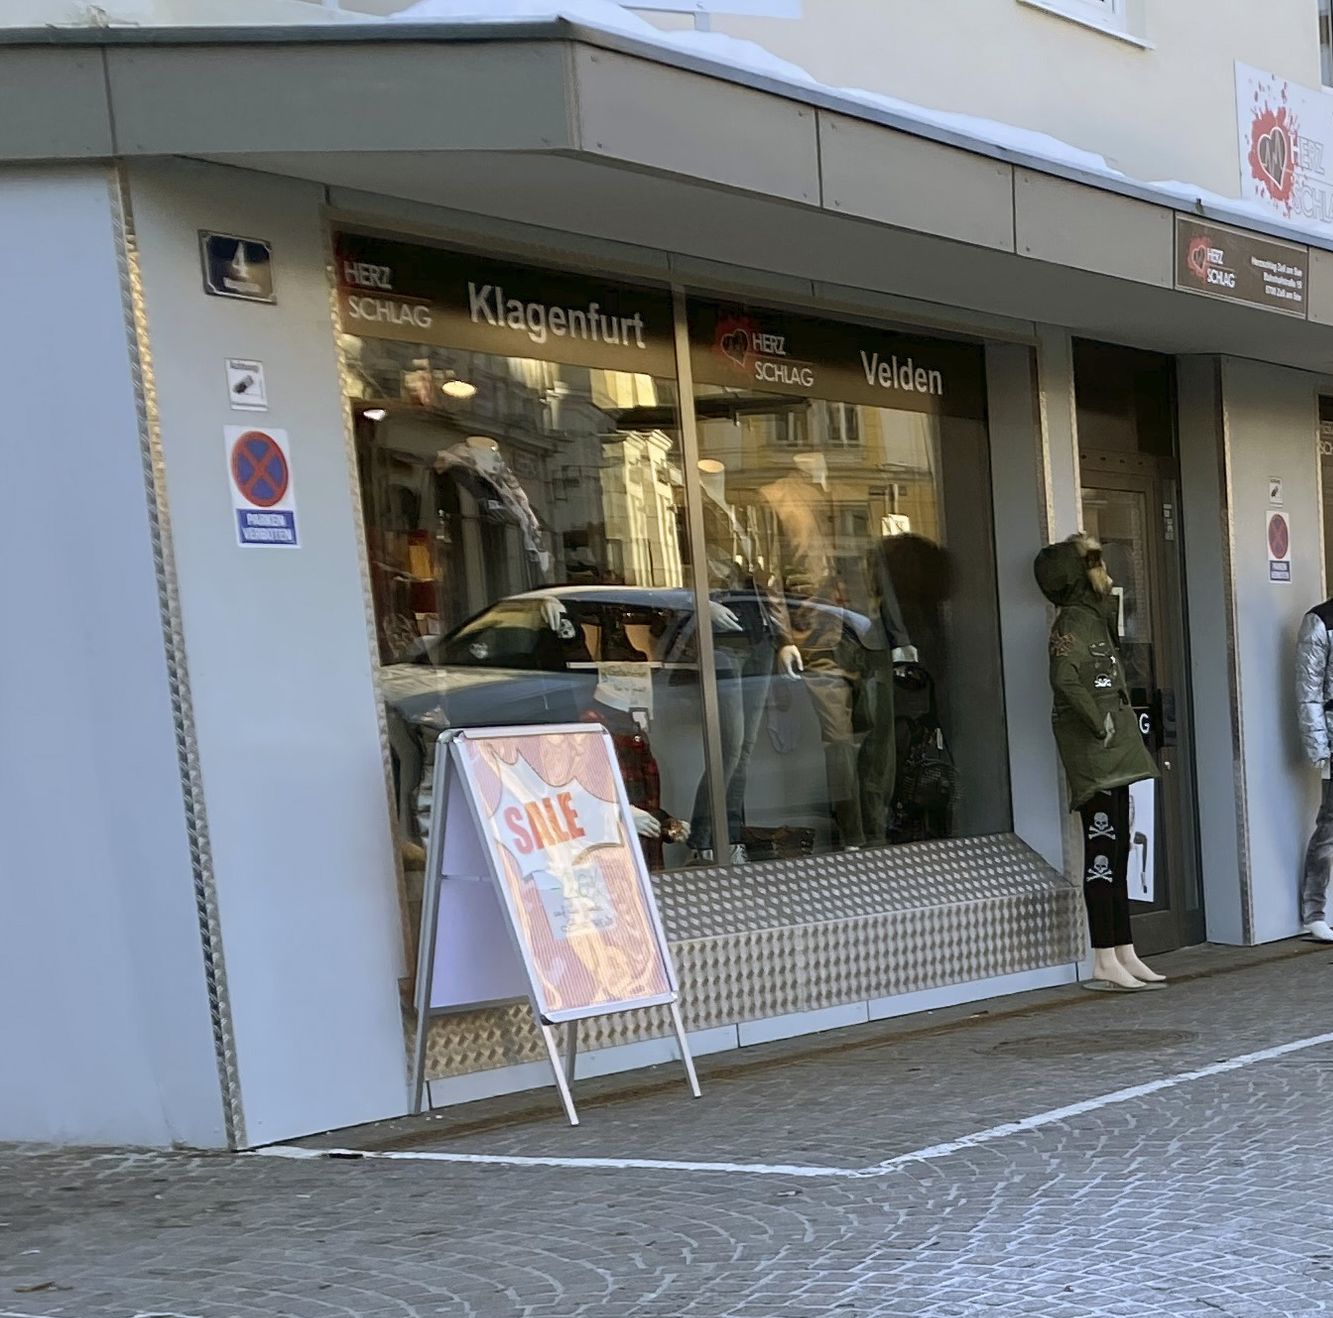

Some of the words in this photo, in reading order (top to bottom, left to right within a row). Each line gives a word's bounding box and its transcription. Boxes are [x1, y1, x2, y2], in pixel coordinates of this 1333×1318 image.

[232, 241, 250, 279] 4
[344, 261, 393, 290] HERZ
[1206, 268, 1236, 289] SCHLAG
[347, 295, 433, 329] SCHLAG
[467, 281, 647, 350] Klagenfurt
[752, 332, 787, 356] HERZ
[754, 361, 815, 388] SCHLAG
[860, 350, 944, 396] Velden
[241, 526, 294, 542] VERBOTEN
[246, 512, 287, 528] PARKEN
[503, 791, 587, 856] SALE
